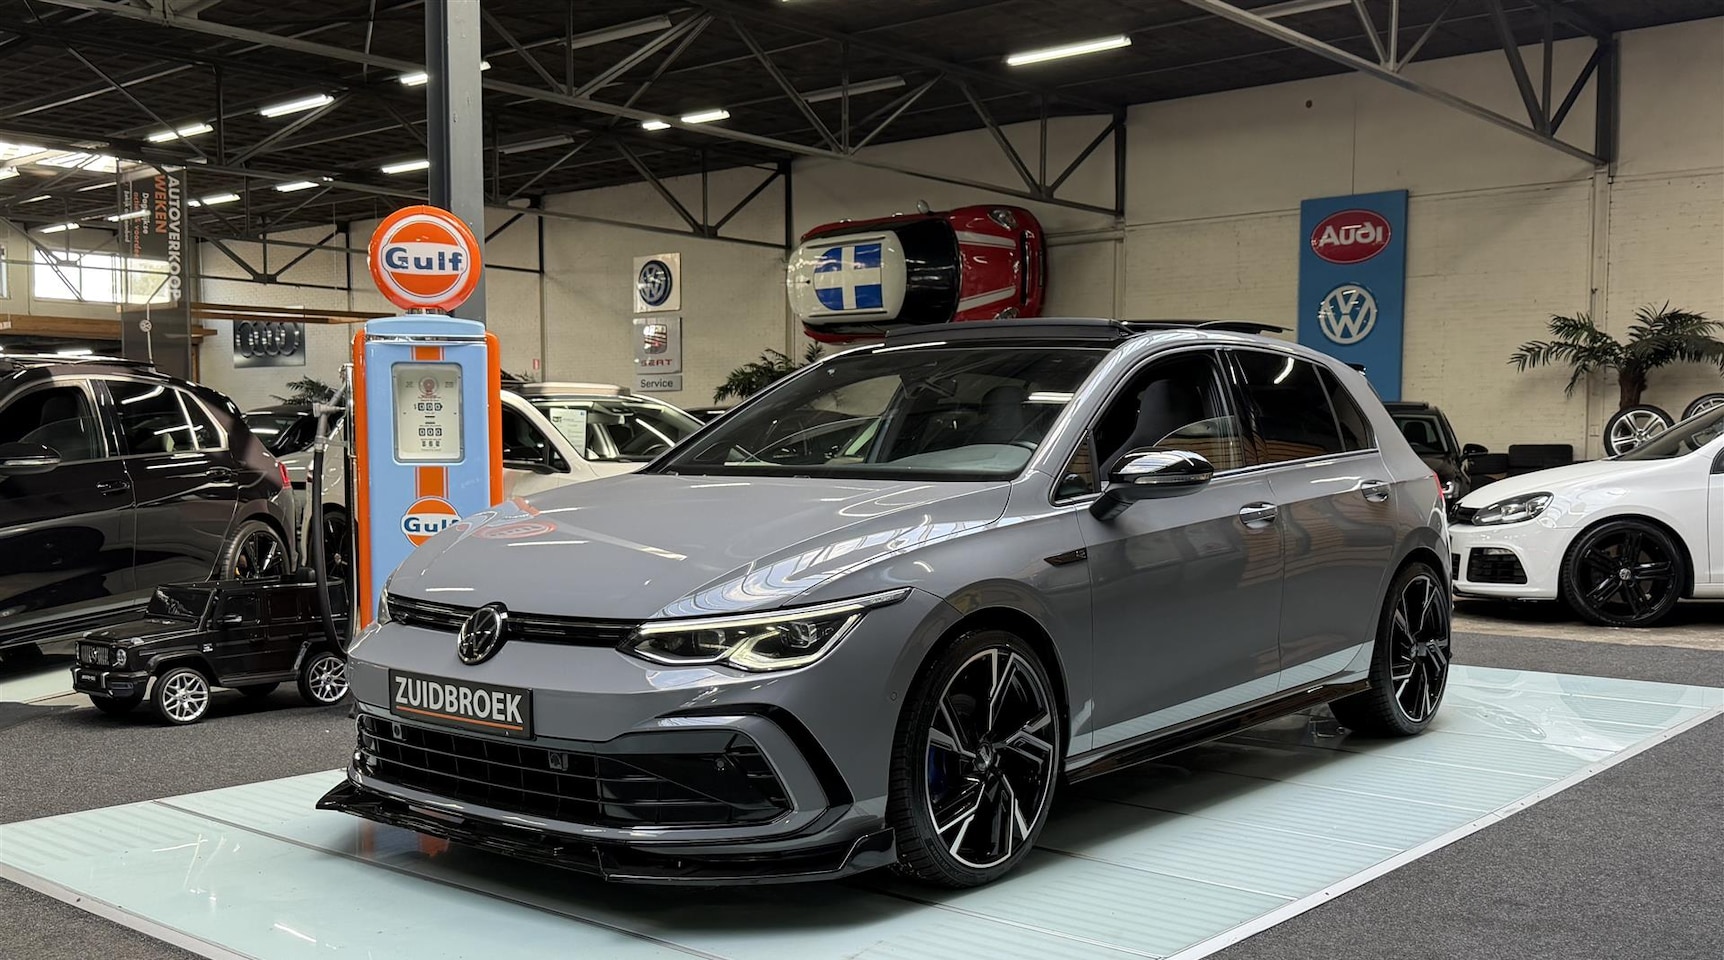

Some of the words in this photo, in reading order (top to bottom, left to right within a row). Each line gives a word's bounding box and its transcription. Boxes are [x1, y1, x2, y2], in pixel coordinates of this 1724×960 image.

[154, 174, 167, 234] WEKEN
[167, 175, 182, 301] AUTOVERKOOP
[385, 247, 463, 271] Gulf
[640, 379, 673, 388] Service
[395, 676, 523, 724] ZUIDBROEK
